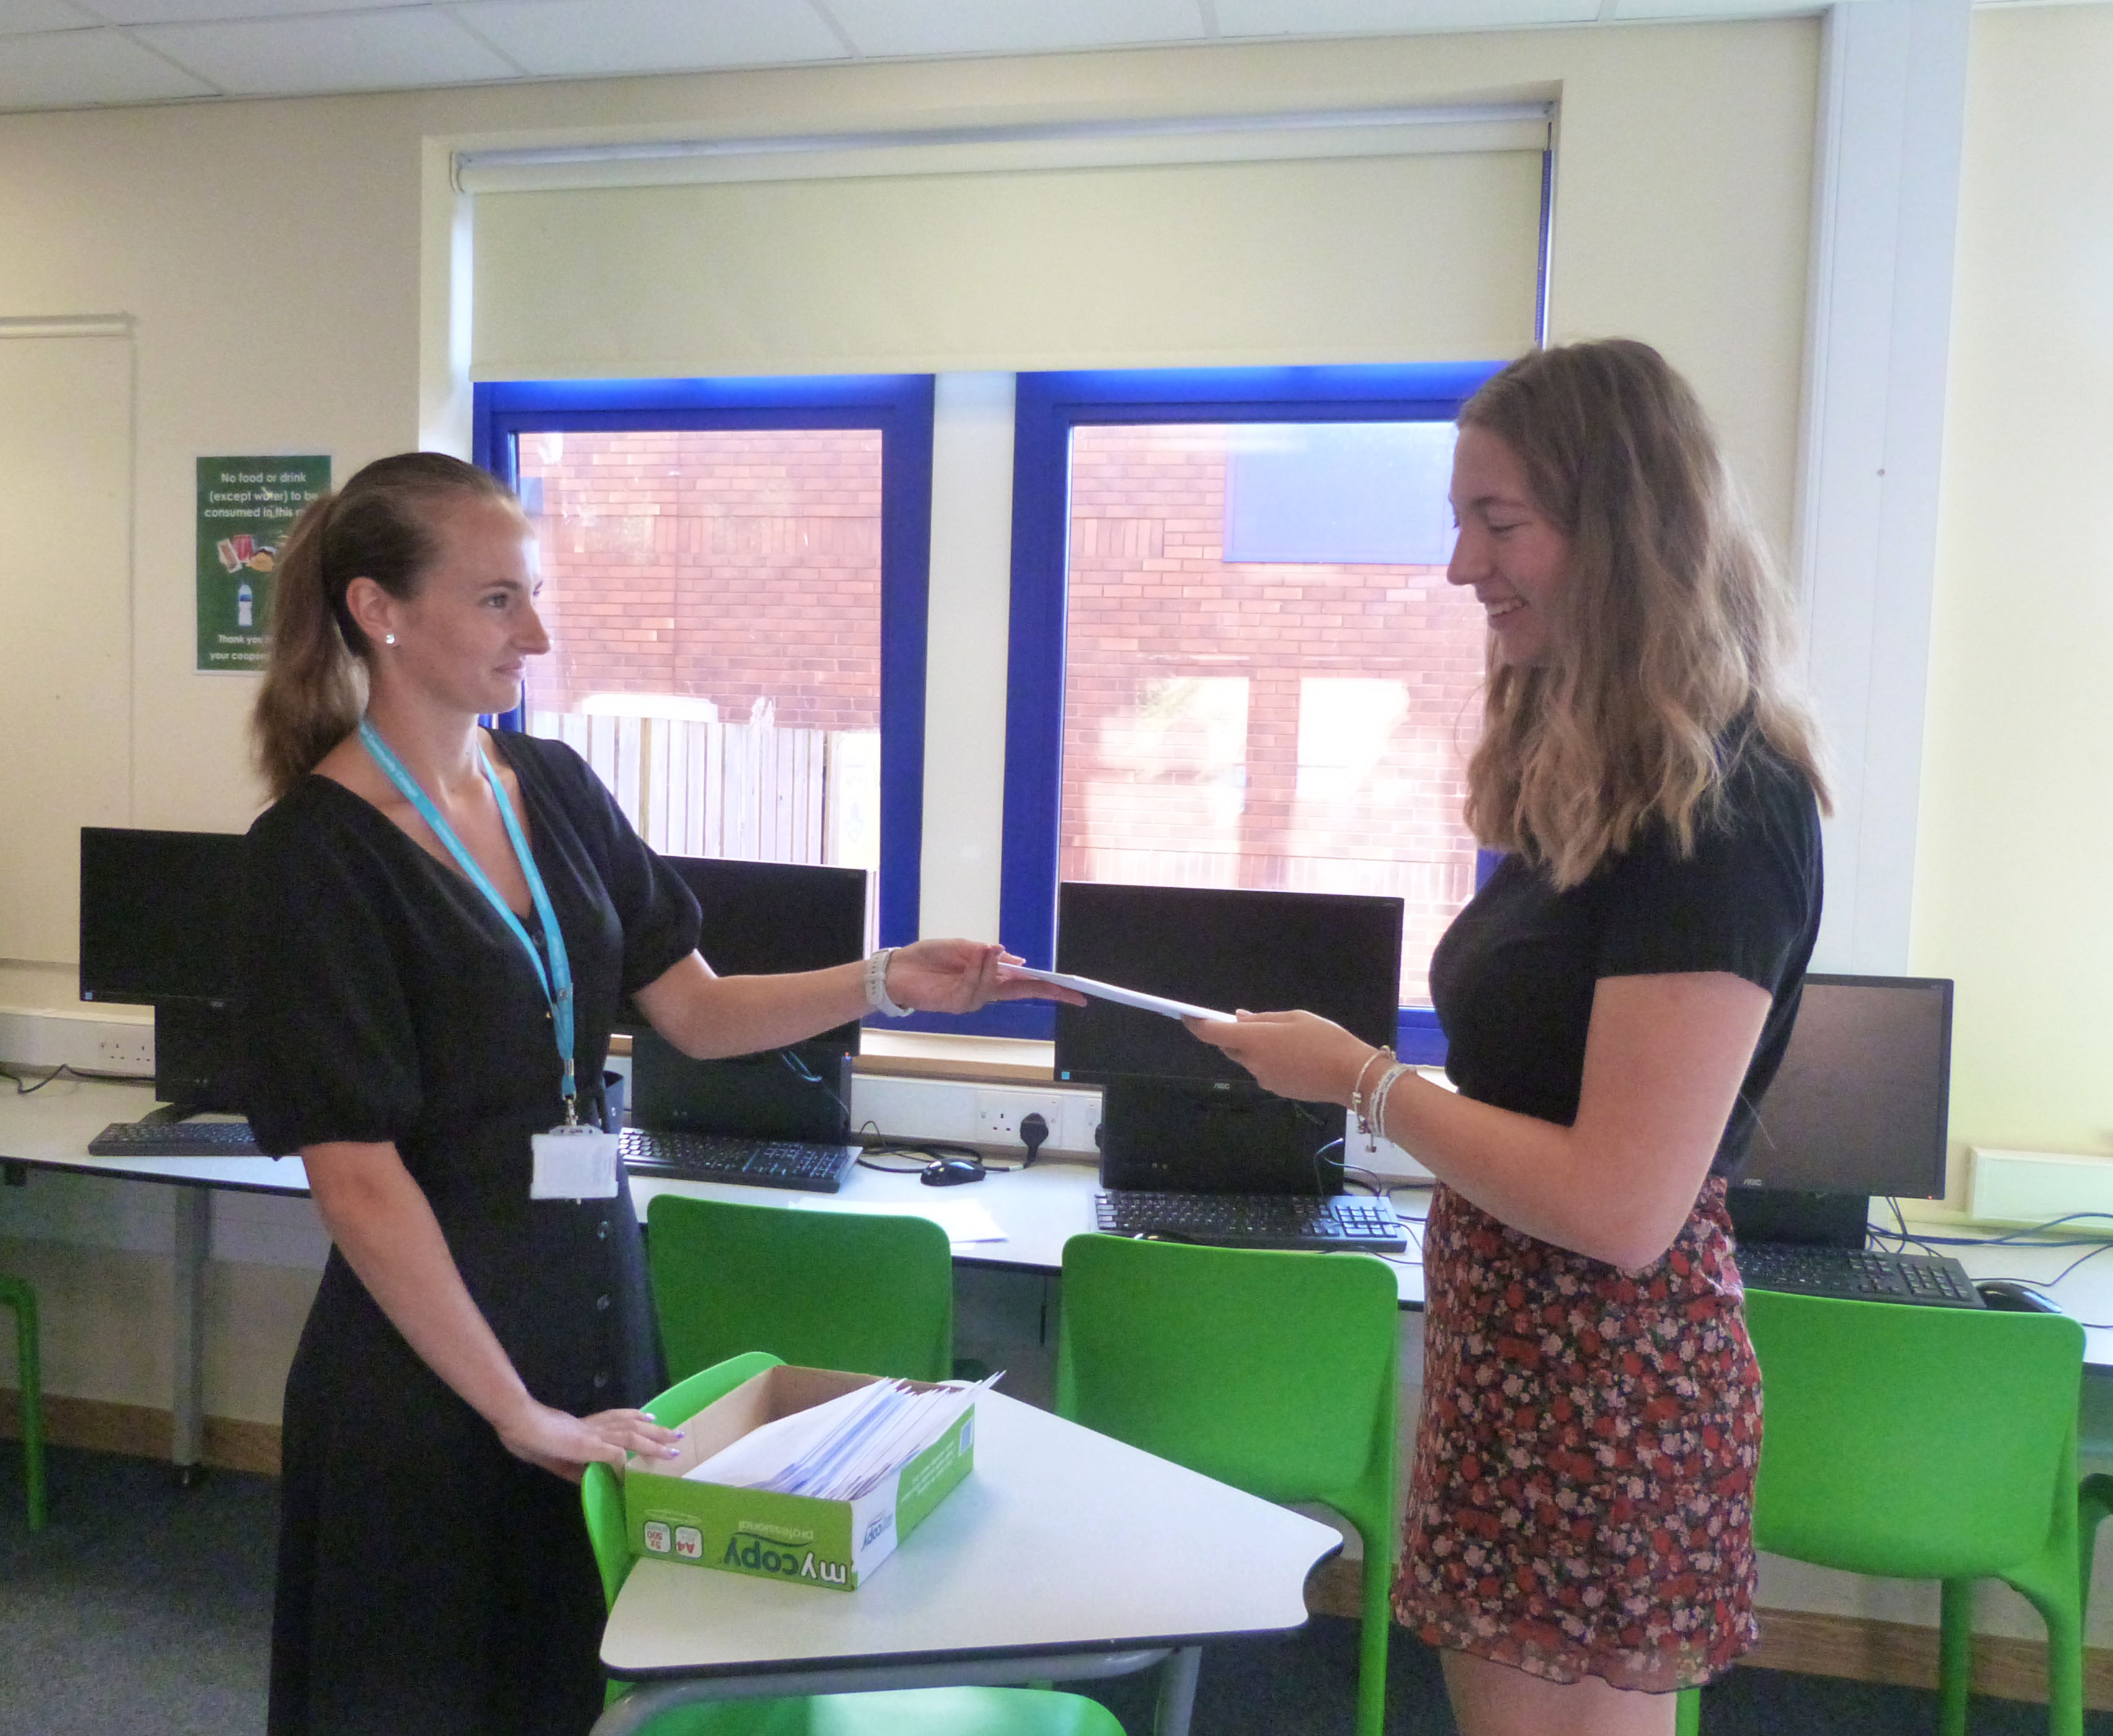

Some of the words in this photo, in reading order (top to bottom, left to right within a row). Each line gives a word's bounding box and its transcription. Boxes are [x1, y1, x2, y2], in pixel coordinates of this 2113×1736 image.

[221, 473, 236, 482] No
[239, 472, 263, 482] food
[280, 472, 306, 482] drink
[210, 491, 250, 503] (except
[254, 490, 288, 503] water)
[290, 491, 301, 501] to
[304, 491, 319, 501] be
[205, 507, 260, 517] consumed
[264, 507, 273, 517] in
[275, 507, 293, 517] this
[218, 634, 245, 644] Thank
[210, 653, 229, 661] your
[647, 1530, 663, 1541] 500
[738, 1521, 814, 1539] professional
[677, 1541, 695, 1554] A4
[724, 1538, 847, 1583] mycopy
